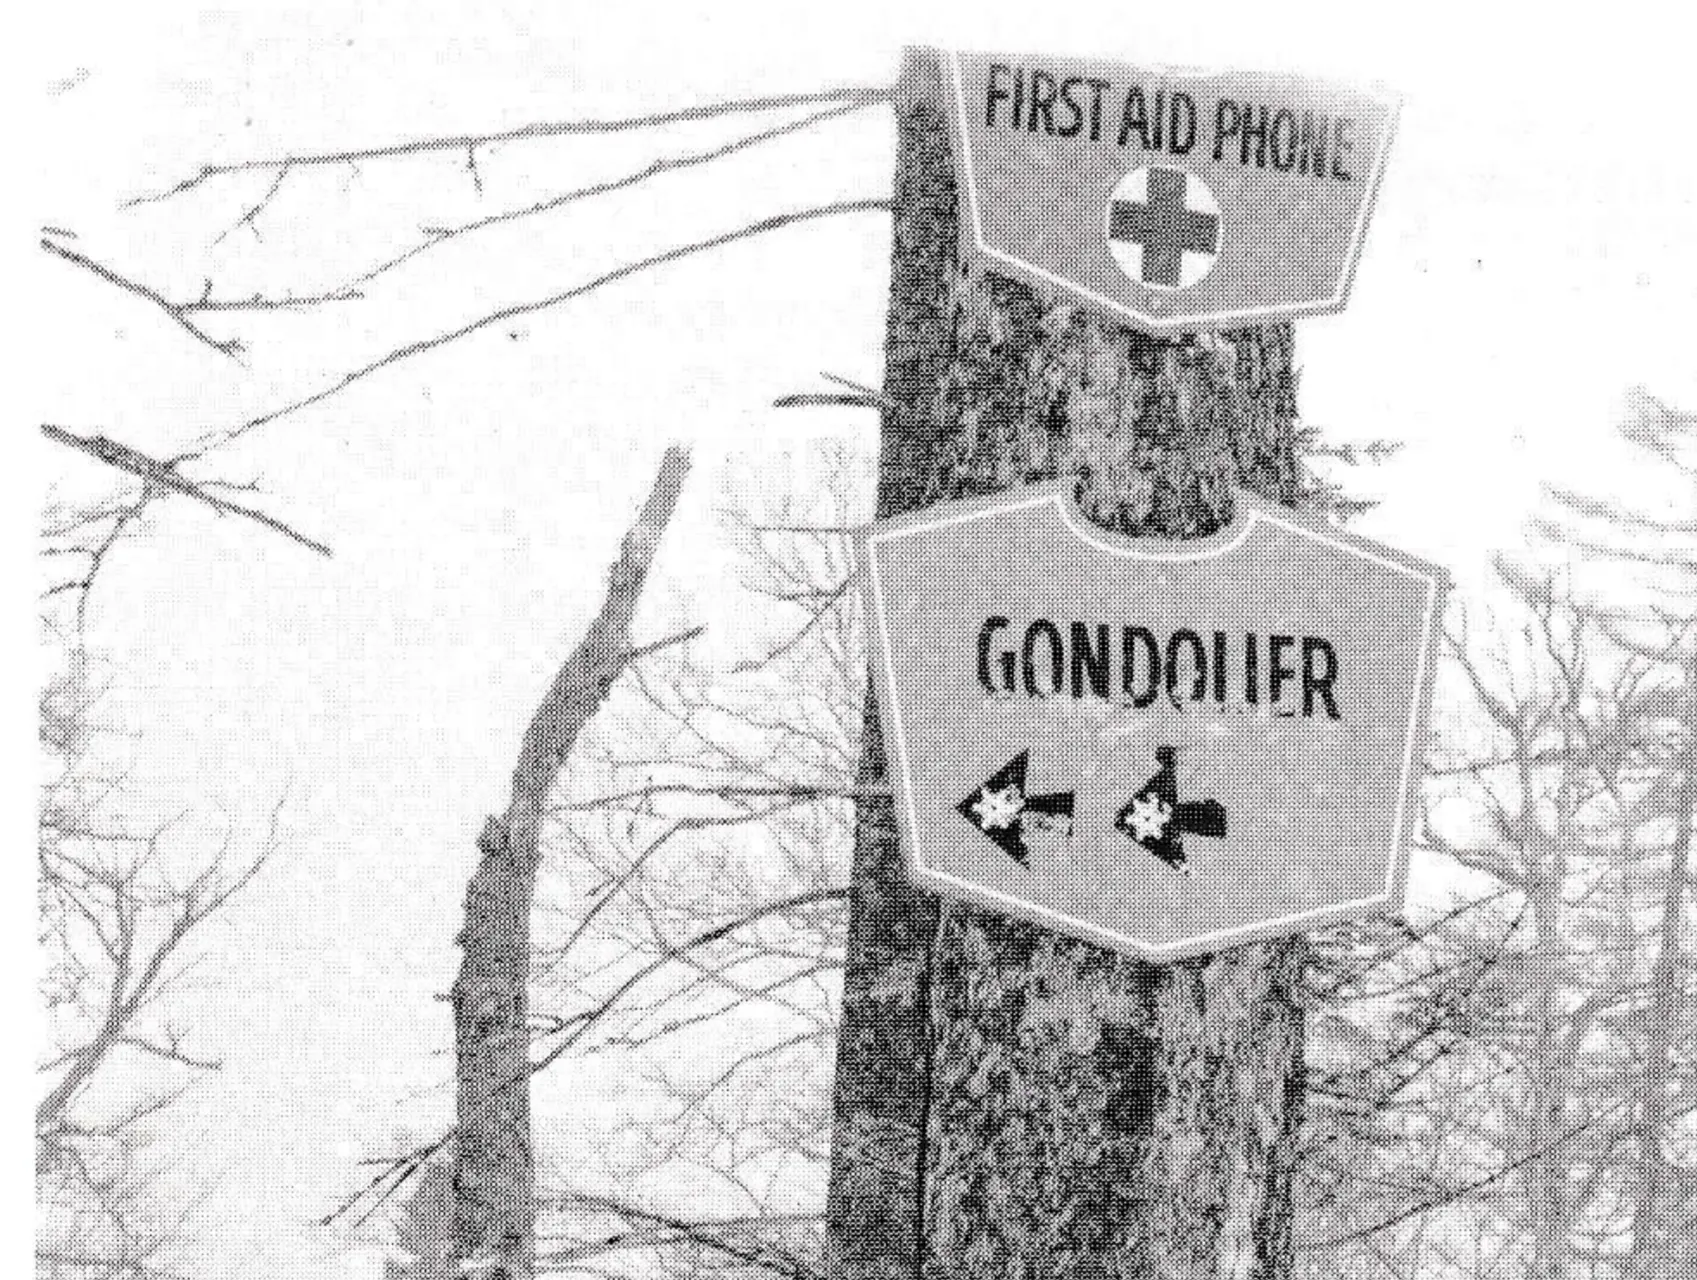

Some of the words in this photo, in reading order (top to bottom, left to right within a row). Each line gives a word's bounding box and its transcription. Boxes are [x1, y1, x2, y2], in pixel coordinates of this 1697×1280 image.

[985, 64, 1110, 142] FIRST
[1116, 86, 1197, 155] AID
[1211, 99, 1353, 182] PHONE
